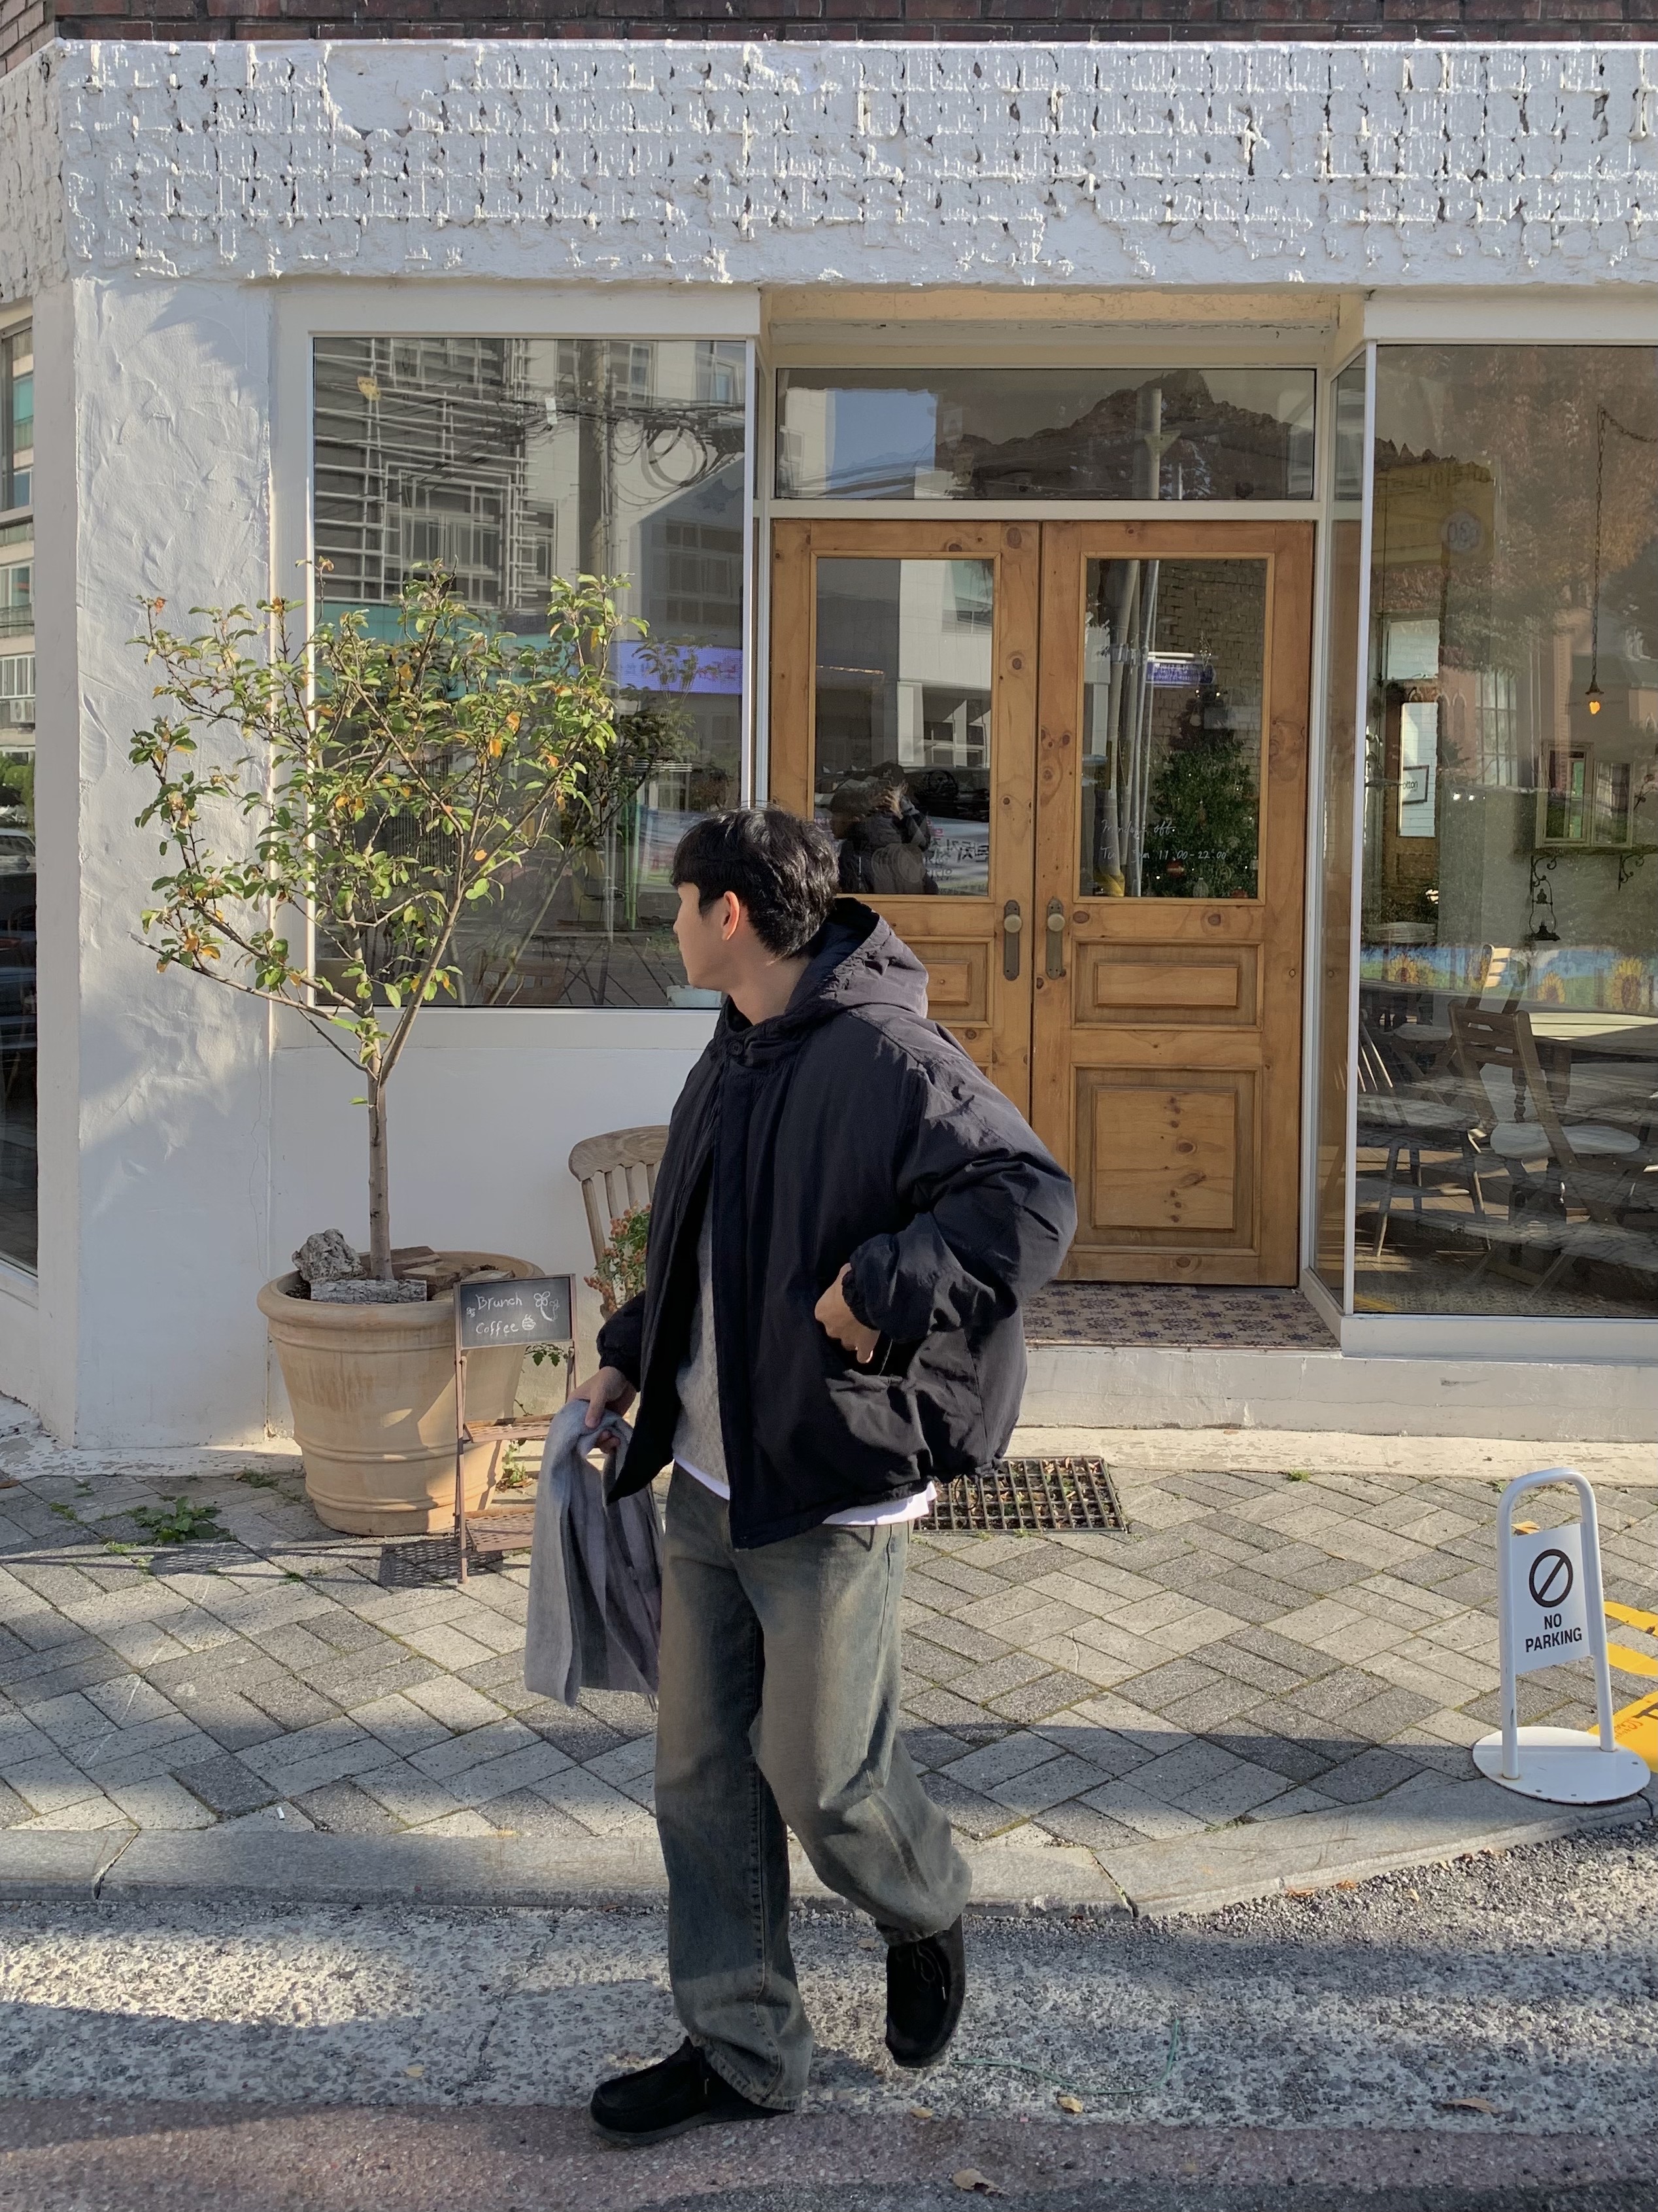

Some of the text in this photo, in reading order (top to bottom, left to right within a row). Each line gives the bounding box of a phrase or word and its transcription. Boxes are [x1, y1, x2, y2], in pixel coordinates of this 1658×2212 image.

[475, 1292, 523, 1310] Brunch
[475, 1320, 518, 1337] Coffee
[1544, 1613, 1563, 1630] NO
[1525, 1627, 1583, 1653] PARKING
